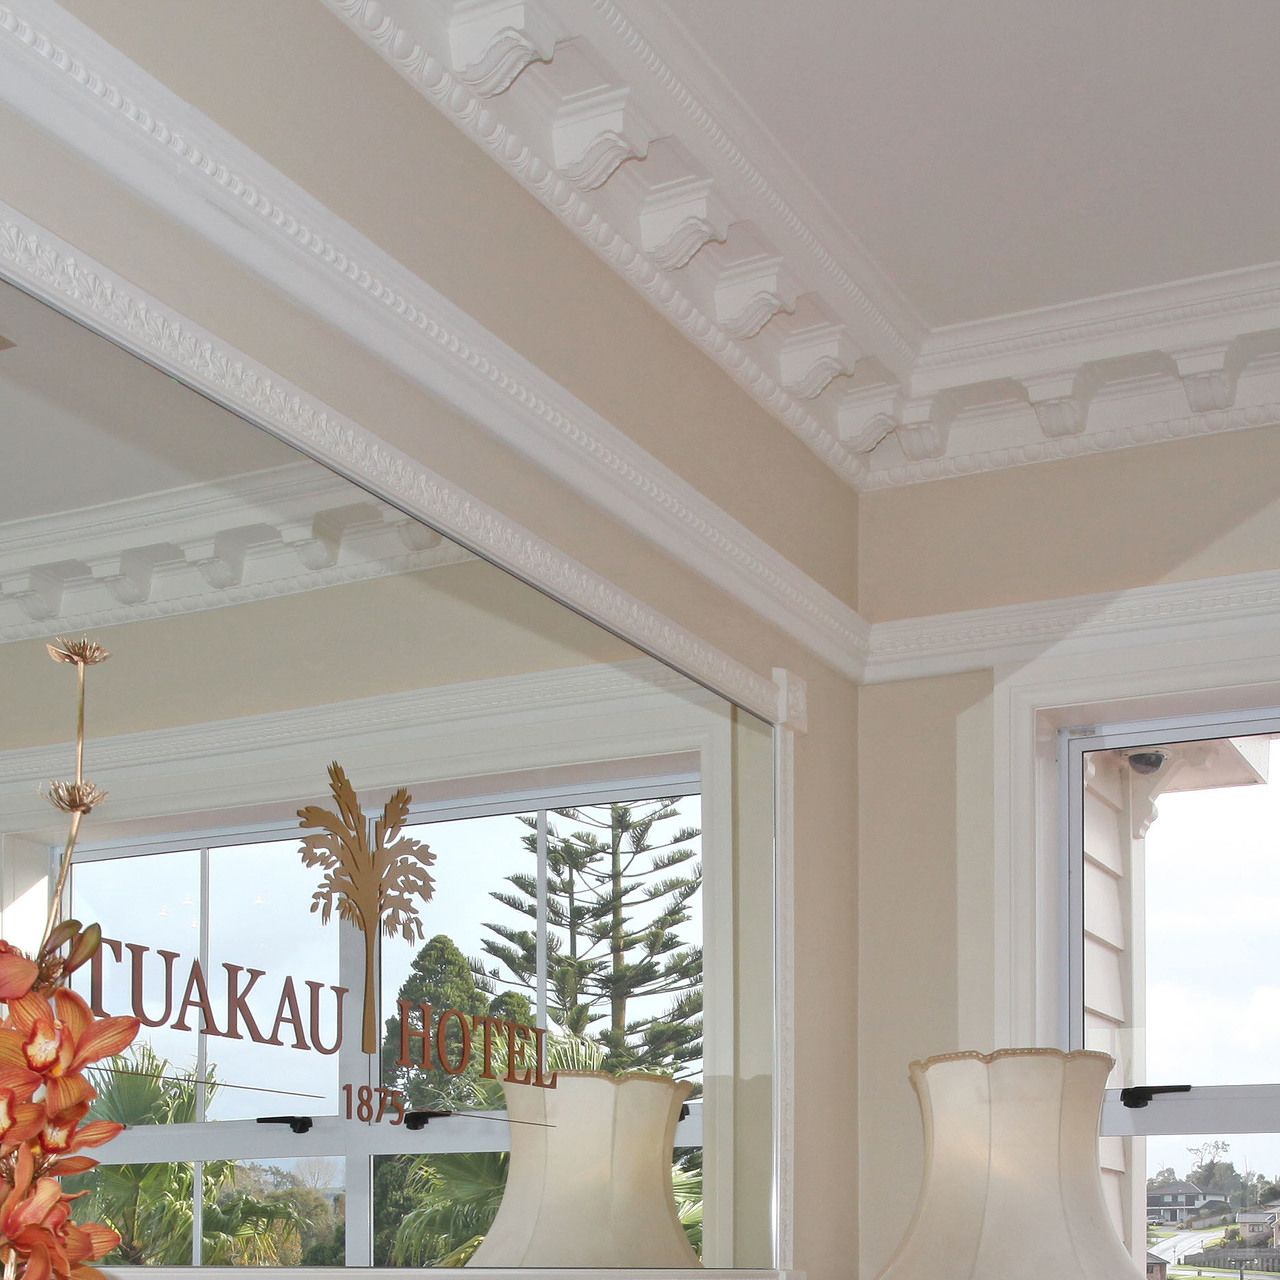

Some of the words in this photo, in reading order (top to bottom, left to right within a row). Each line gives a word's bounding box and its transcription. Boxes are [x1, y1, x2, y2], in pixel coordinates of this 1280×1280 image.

[89, 937, 349, 1055] TUAKAU
[396, 1000, 557, 1089] HOTEL
[343, 1083, 406, 1126] 1875
